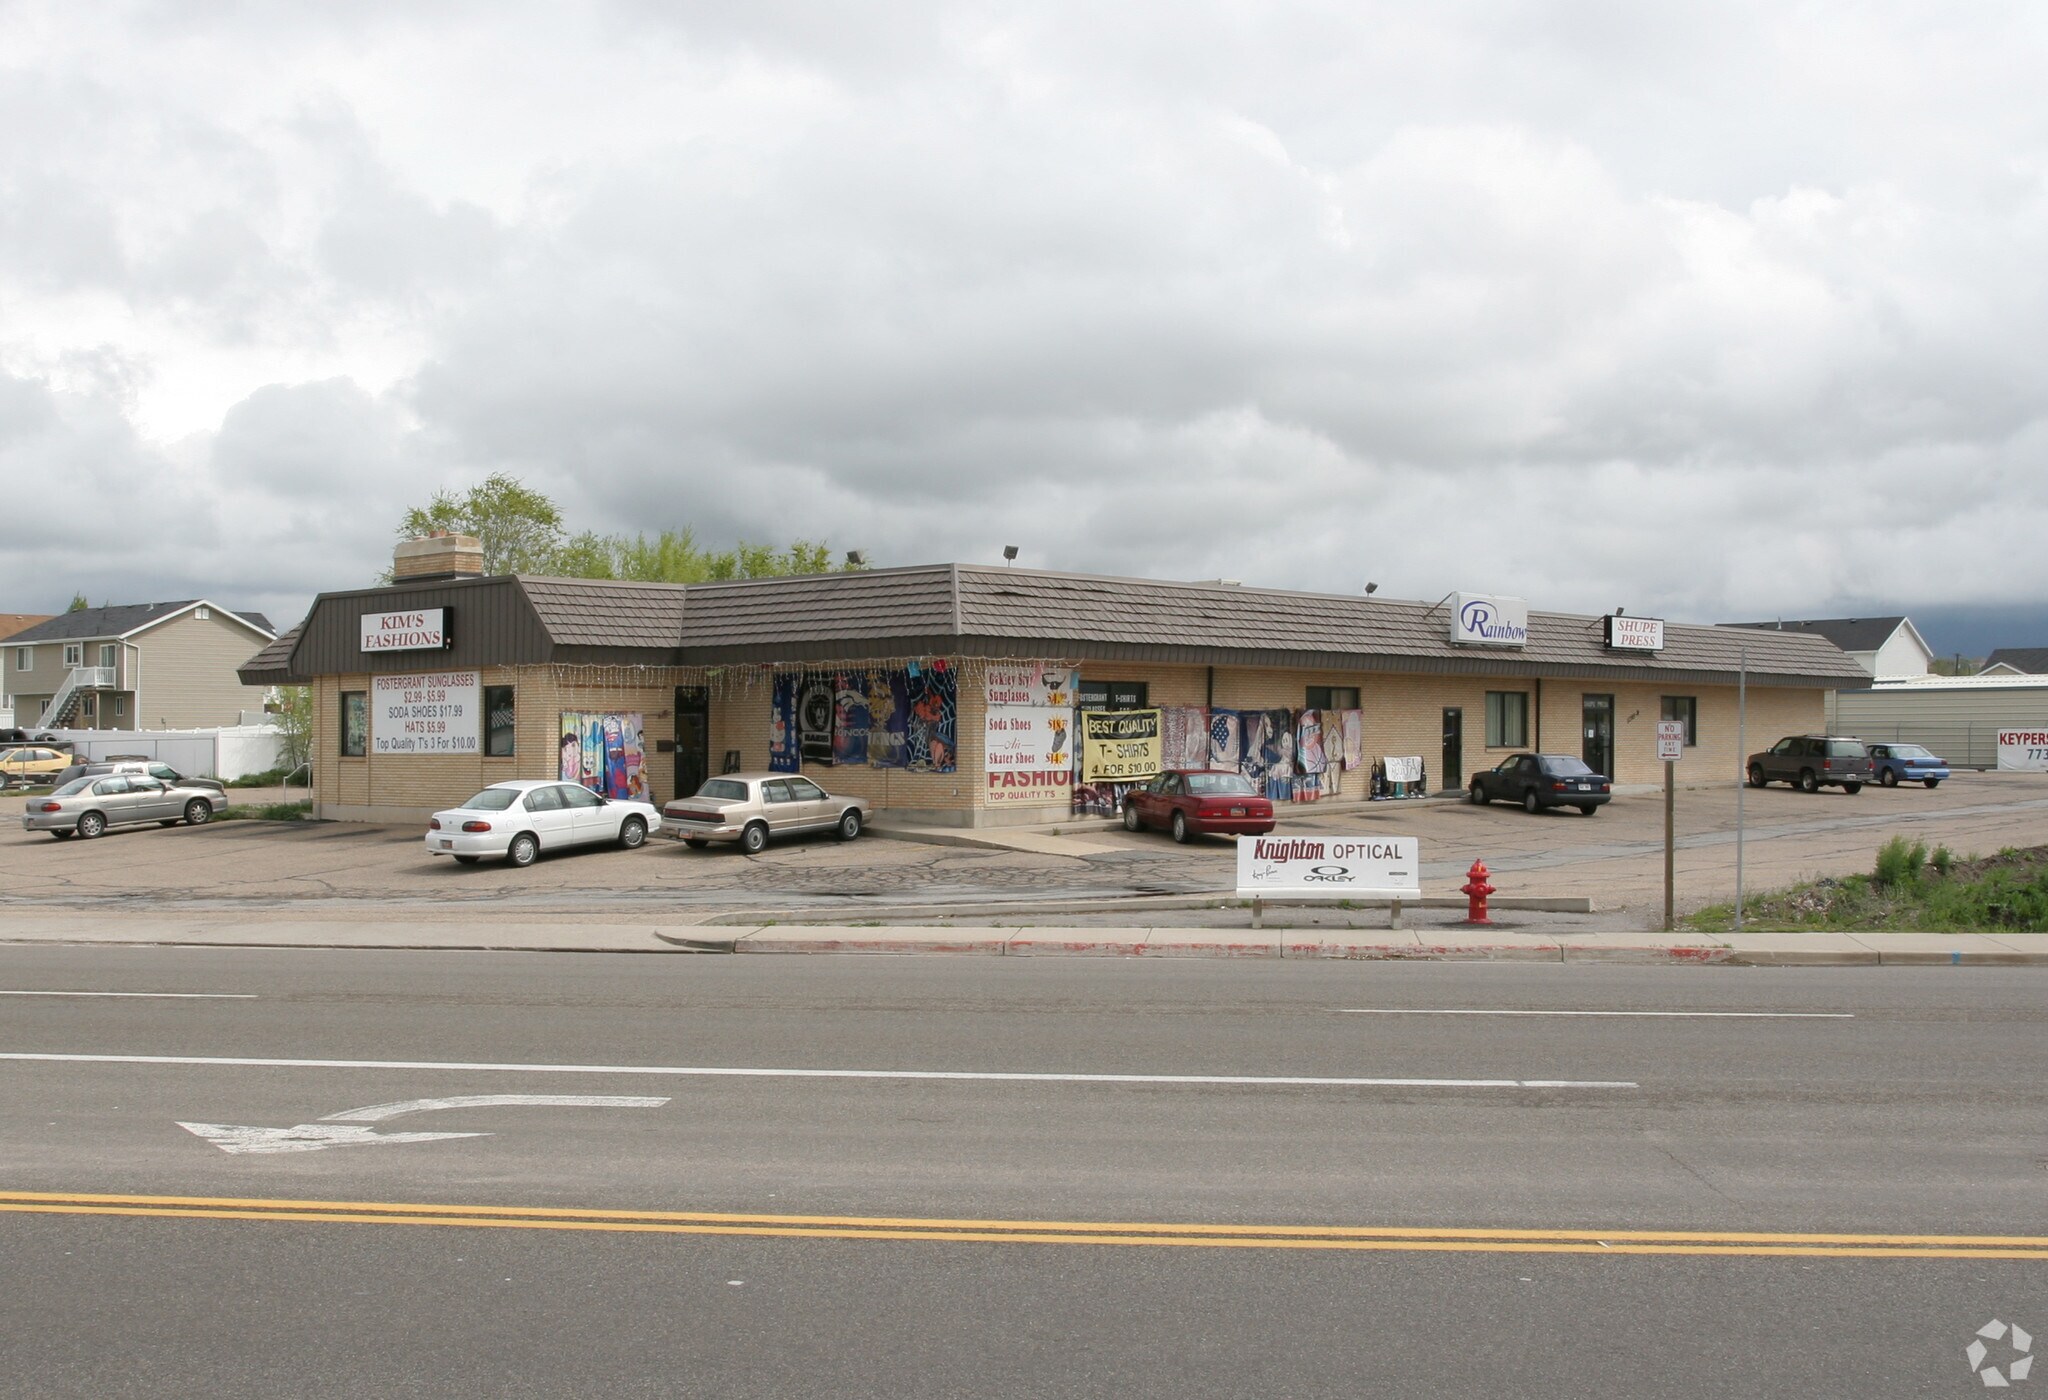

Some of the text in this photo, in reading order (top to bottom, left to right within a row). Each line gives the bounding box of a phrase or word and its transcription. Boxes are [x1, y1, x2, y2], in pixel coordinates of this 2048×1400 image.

[381, 614, 424, 630] KIM'S
[1461, 601, 1526, 639] Rainbow
[1617, 620, 1658, 634] SHUPE
[364, 631, 441, 649] FASHIONS
[1620, 634, 1656, 647] PRESS
[377, 674, 475, 690] FOSTERGRANT SUNGLASSES
[404, 691, 422, 703] $2.99
[427, 690, 446, 702] $5.99
[989, 688, 1030, 704] Sunglasses
[388, 704, 463, 719] SODA SHOES $17.99
[405, 721, 446, 733] HATS $5.99
[989, 718, 1031, 730] Soda Shoes
[1089, 718, 1156, 734] BEST QUALITY
[1664, 725, 1675, 733] NO
[376, 738, 390, 751] Top
[391, 737, 415, 751] Quality
[431, 737, 436, 749] 3
[437, 737, 449, 749] For
[452, 737, 476, 749] $10.00
[989, 752, 1035, 764] Skater Shoes
[1092, 762, 1156, 774] 4 FOR $10.00
[989, 771, 1073, 788] FASHIO
[1008, 791, 1041, 799] QUALITY
[1254, 839, 1402, 863] Knighton OPTICAL
